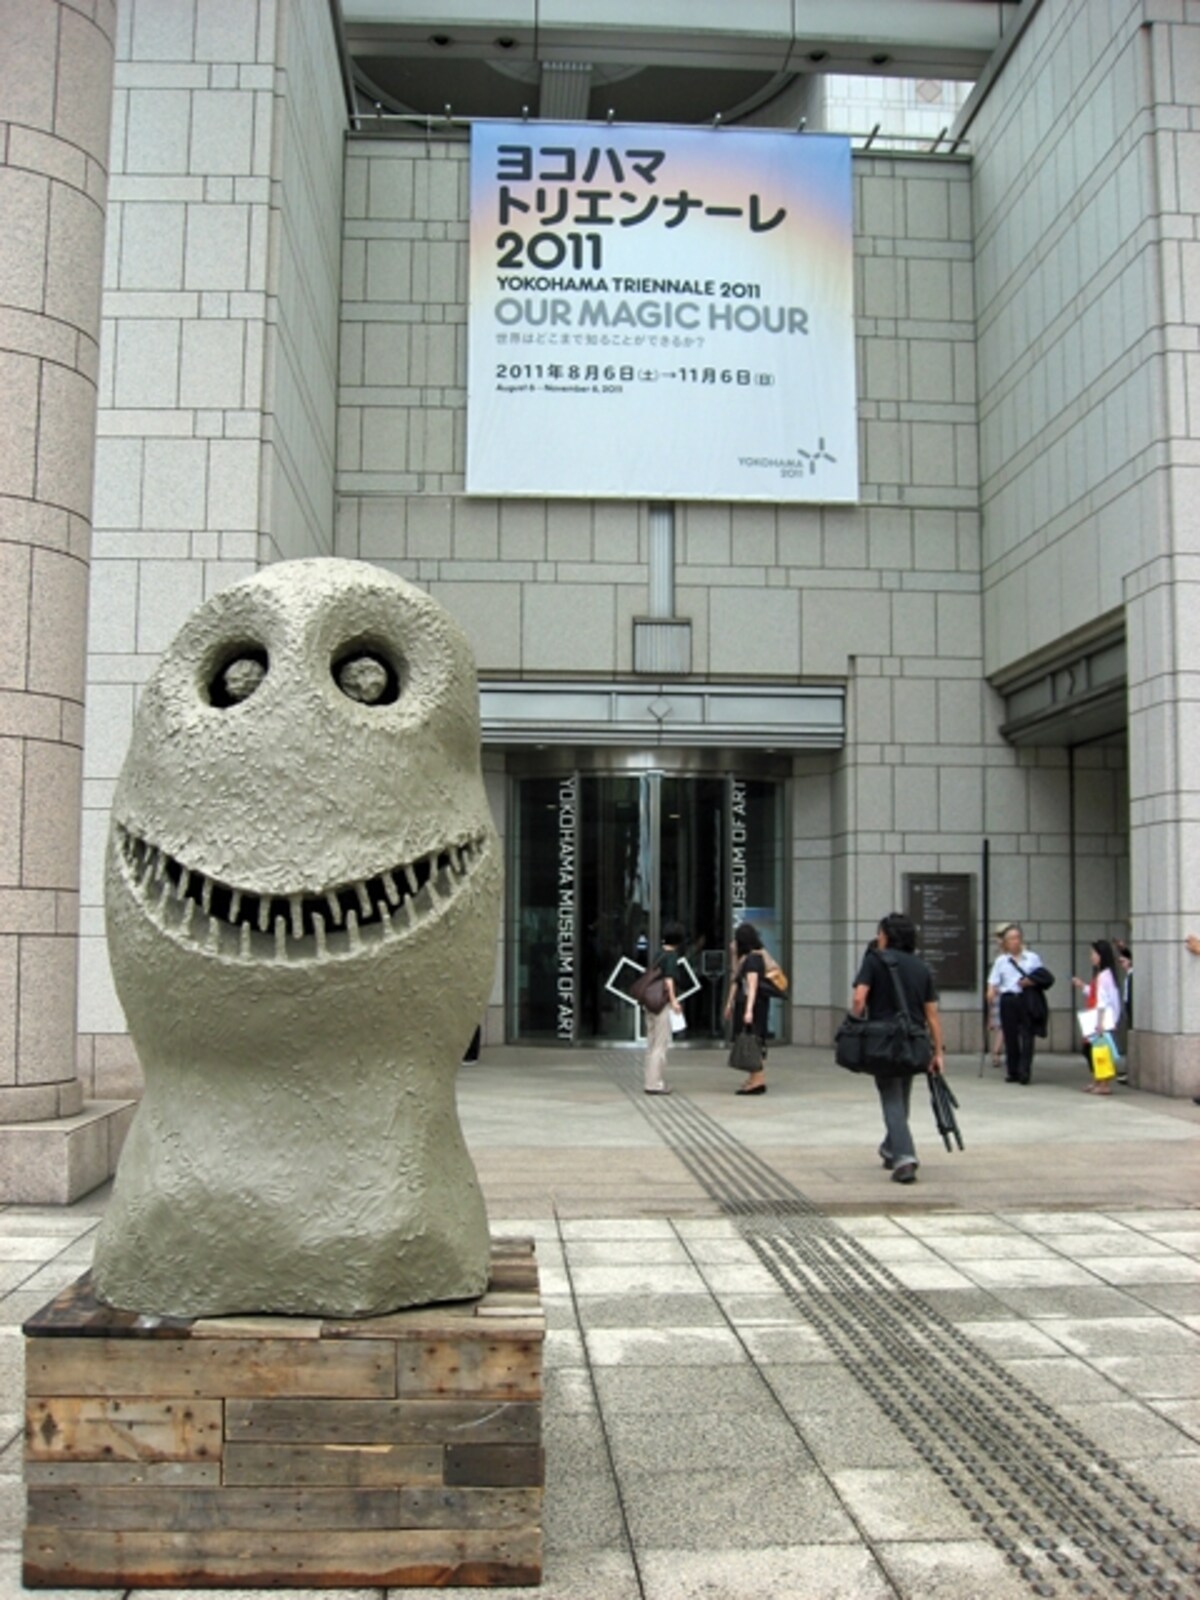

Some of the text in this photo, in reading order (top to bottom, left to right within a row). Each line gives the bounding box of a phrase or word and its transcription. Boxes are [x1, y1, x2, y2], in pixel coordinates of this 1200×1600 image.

[496, 145, 666, 184] ヨコハマ
[498, 185, 787, 233] トリエンナーレ
[496, 231, 602, 270] 2011
[497, 276, 761, 299] YOKOHAMA TRIENNALE 2011
[494, 298, 809, 335] OUR MAGIC HOUR
[738, 457, 804, 468] YOKOHAMA
[780, 468, 804, 478] 2011
[731, 780, 747, 816] ART
[732, 817, 746, 841] OF
[557, 777, 577, 1041] YOKOHAMA MUSEUM OF ART
